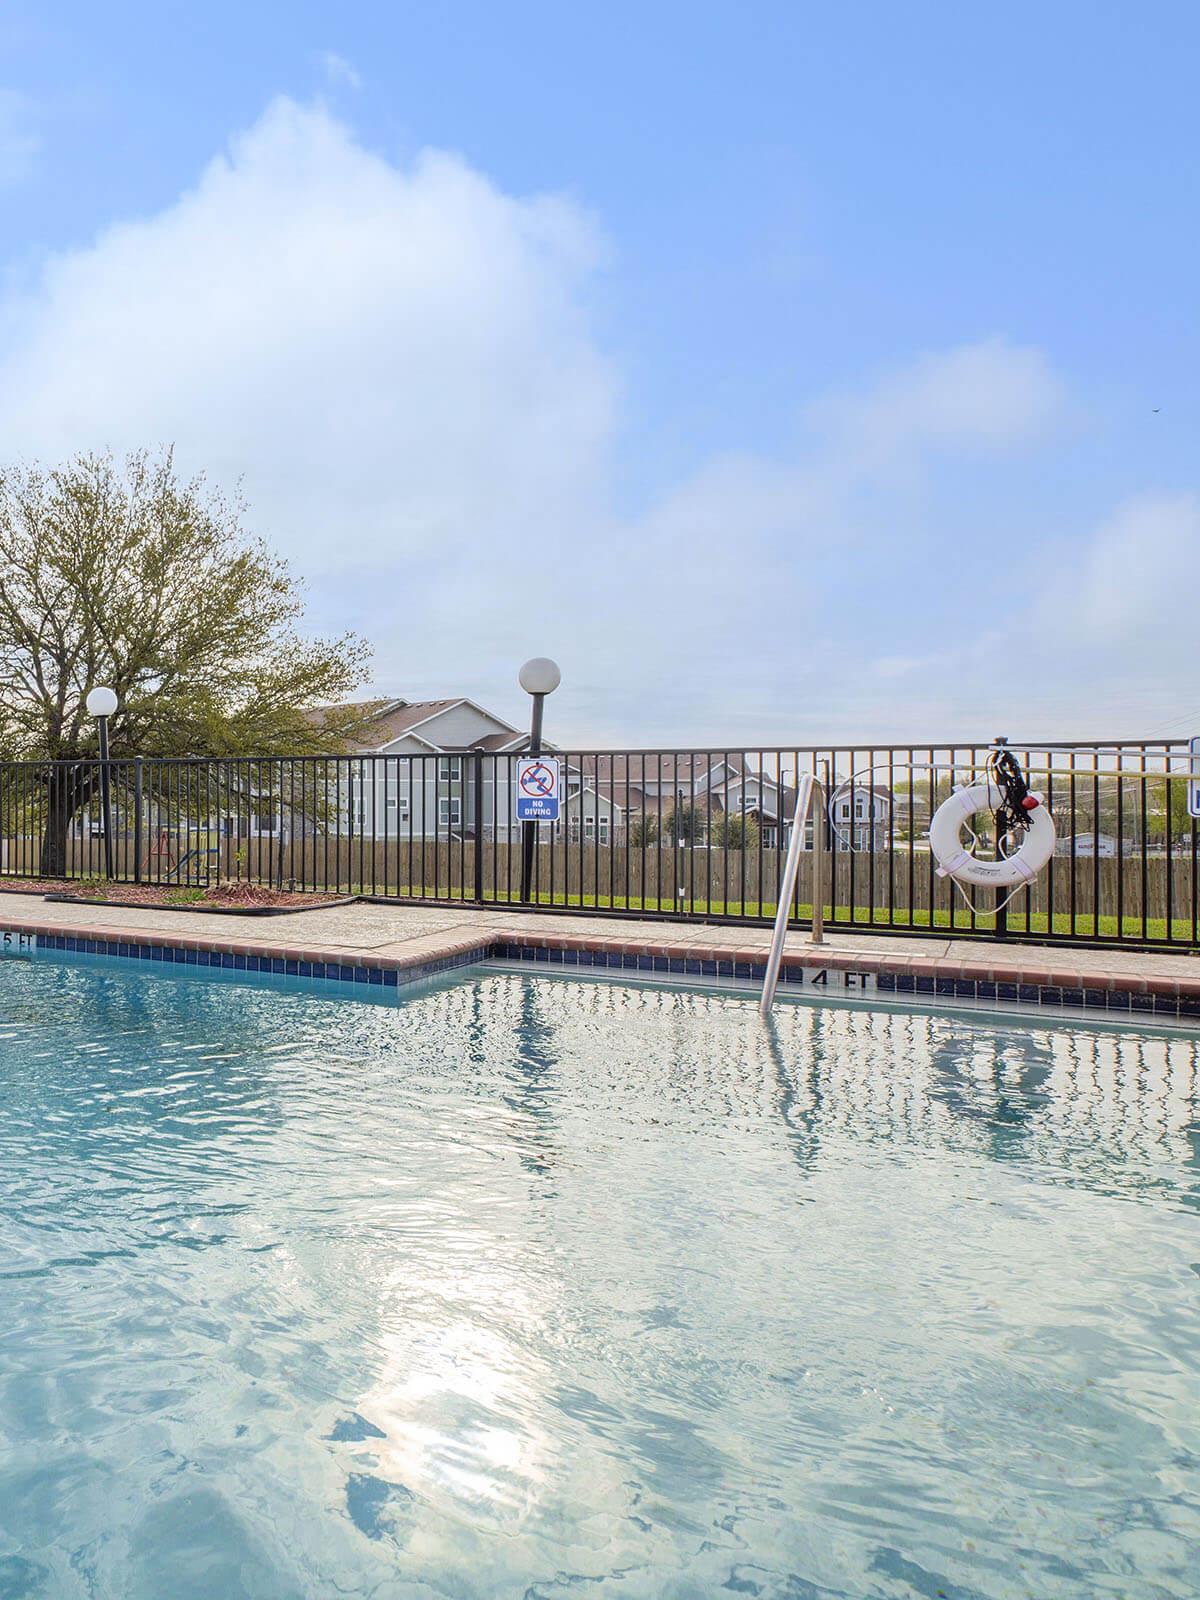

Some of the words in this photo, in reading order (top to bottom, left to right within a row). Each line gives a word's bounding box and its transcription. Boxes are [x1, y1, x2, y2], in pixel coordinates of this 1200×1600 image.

[524, 807, 551, 815] DIVING
[3, 932, 12, 944] 5
[19, 934, 32, 946] FT
[811, 969, 828, 984] 4
[844, 971, 870, 988] FT
